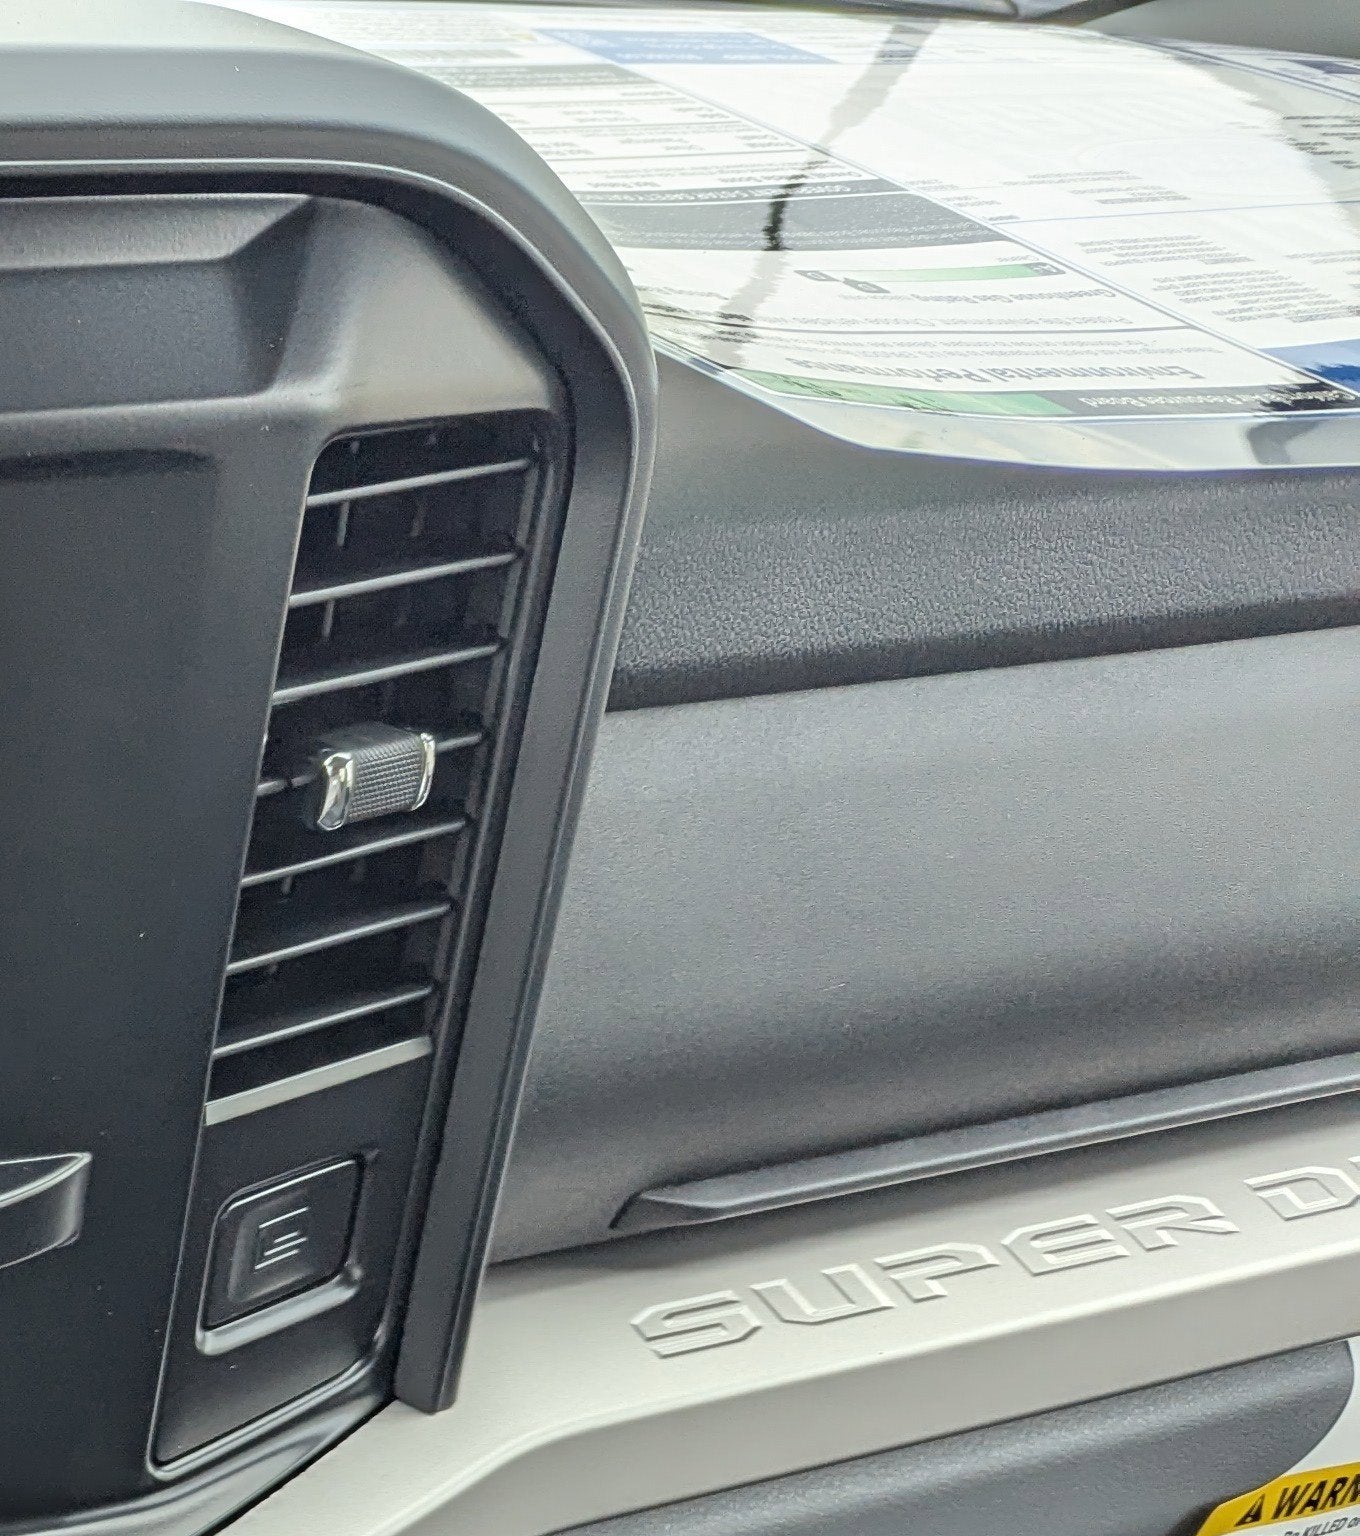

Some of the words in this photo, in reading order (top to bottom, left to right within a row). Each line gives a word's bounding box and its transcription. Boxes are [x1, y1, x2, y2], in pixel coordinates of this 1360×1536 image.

[783, 357, 992, 383] Performance
[988, 365, 1206, 382] Environmental
[629, 1193, 1242, 1359] SUPER
[1243, 1156, 1360, 1222] D
